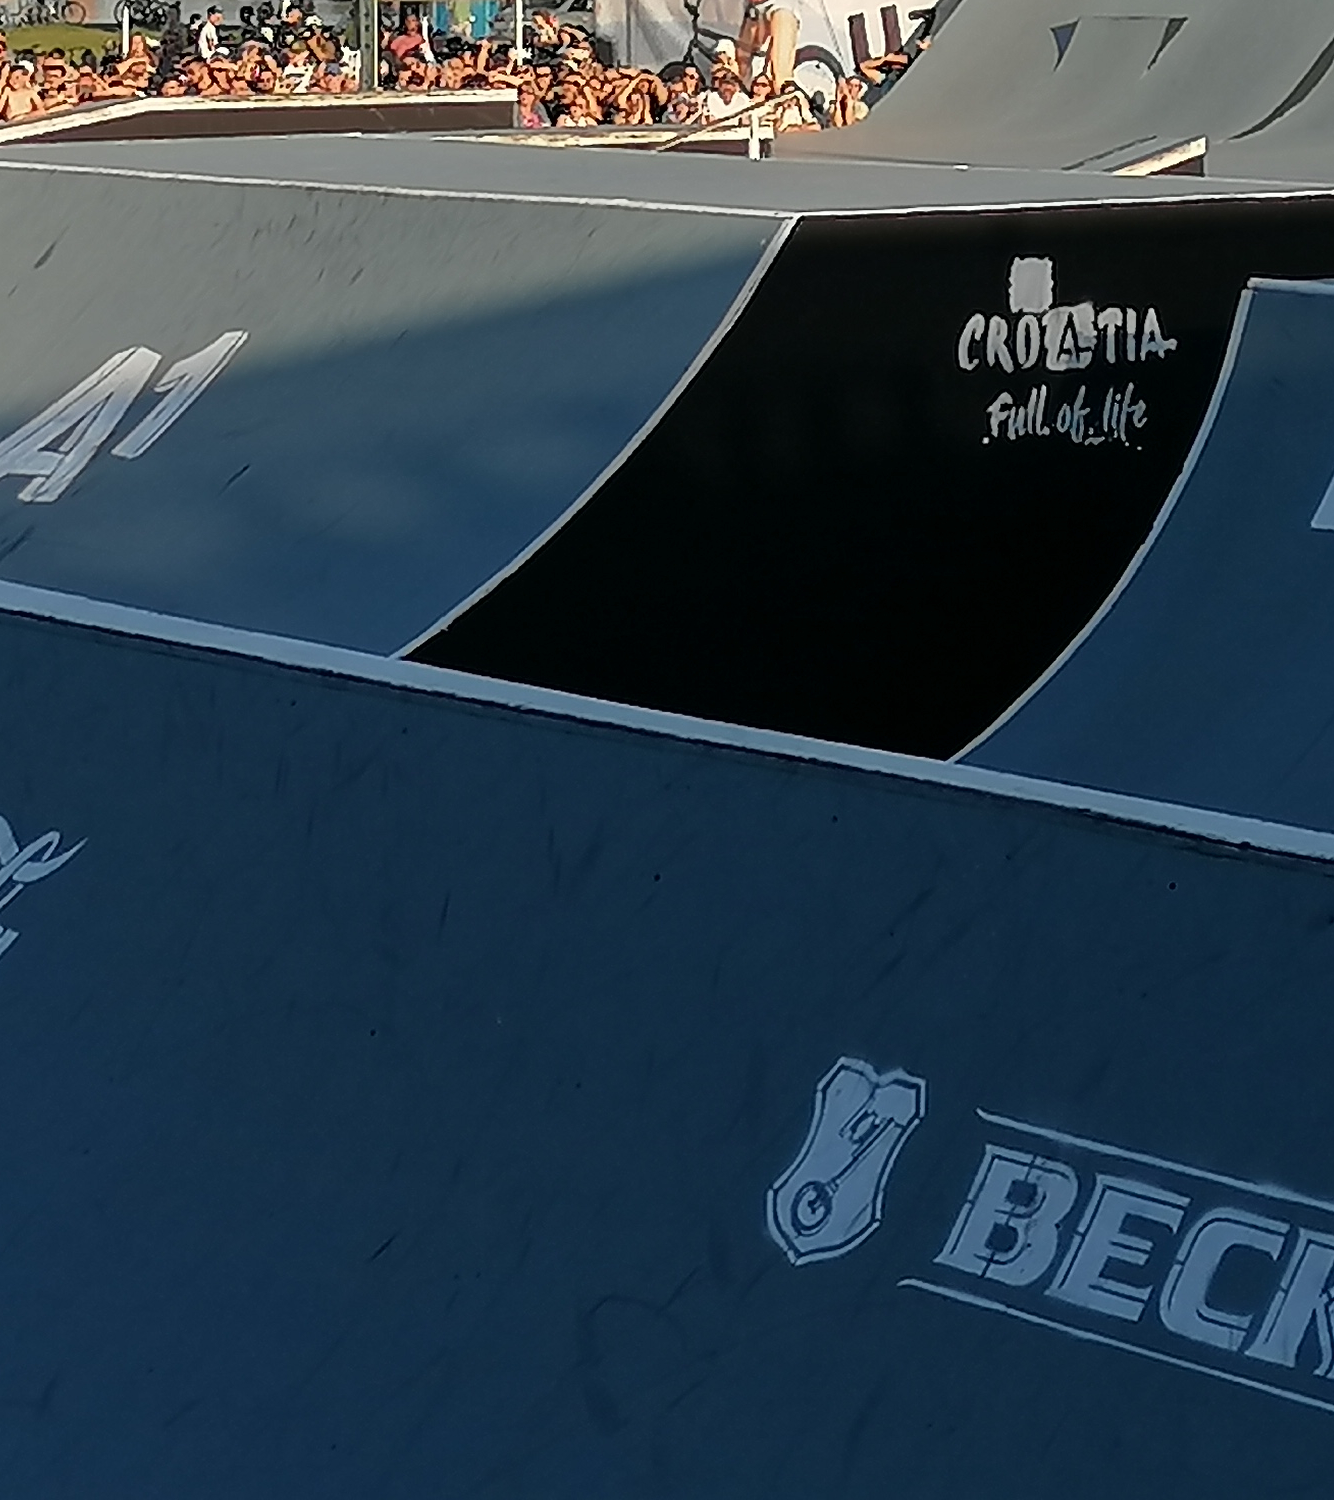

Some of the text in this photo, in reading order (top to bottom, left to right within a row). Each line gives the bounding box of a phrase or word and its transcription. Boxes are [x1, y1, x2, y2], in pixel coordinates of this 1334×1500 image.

[958, 302, 1178, 373] CROATIA
[986, 384, 1050, 440] Full
[1102, 382, 1148, 442] life
